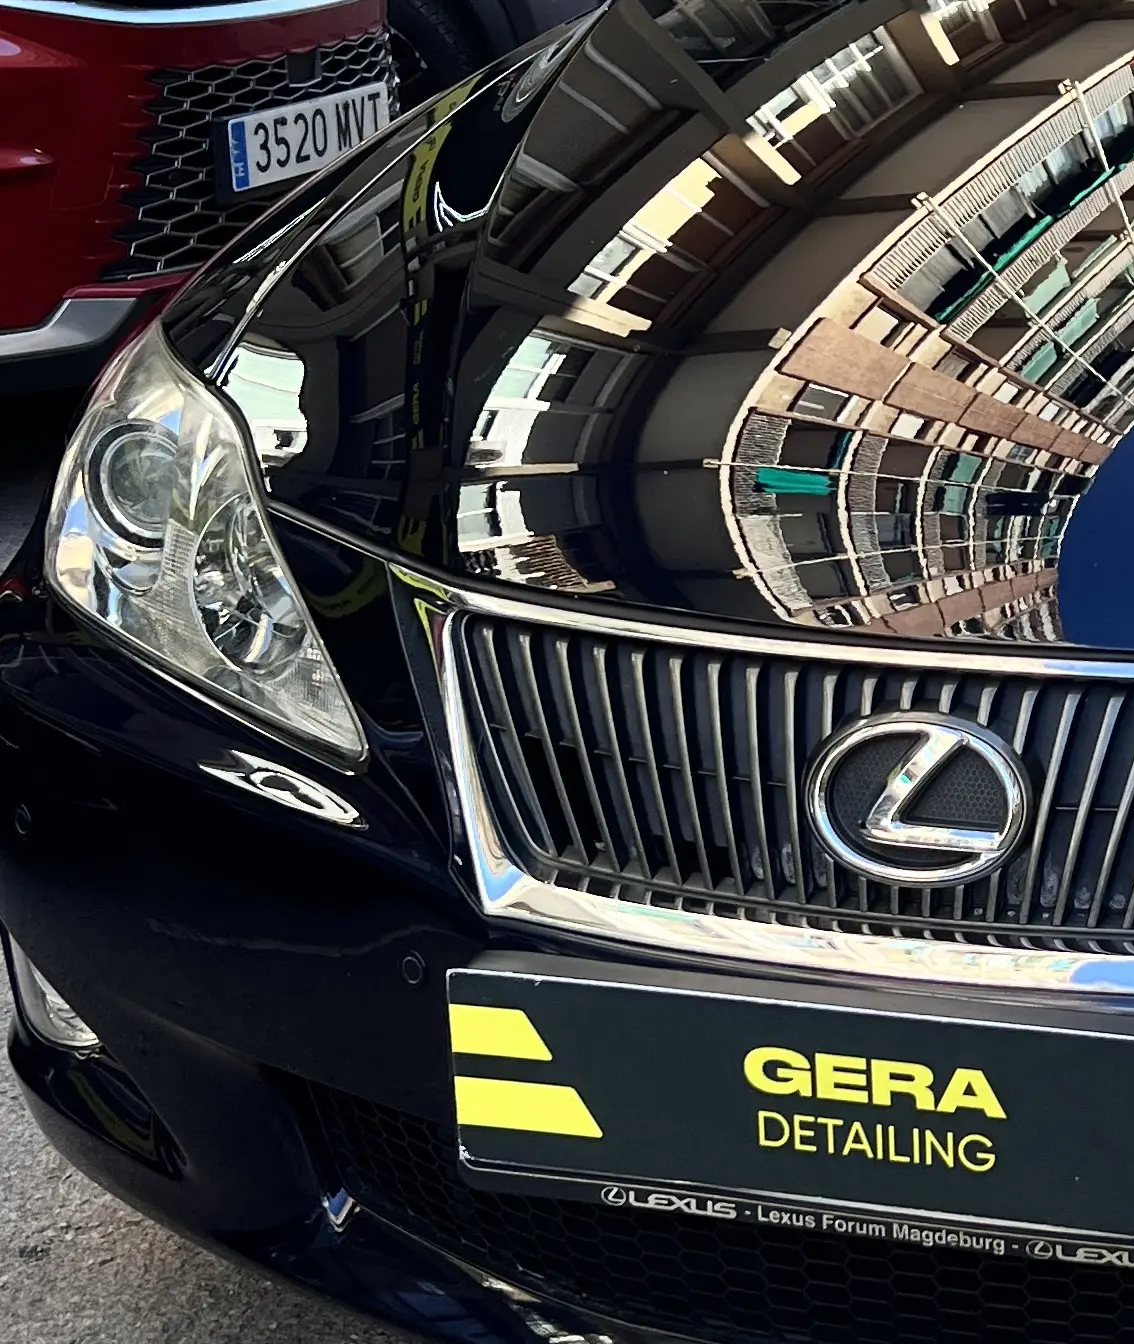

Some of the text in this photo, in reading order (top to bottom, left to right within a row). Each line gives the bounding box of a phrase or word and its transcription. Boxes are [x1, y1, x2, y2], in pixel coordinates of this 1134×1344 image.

[254, 92, 381, 173] 3520 MVT
[743, 1046, 1007, 1119] GERA
[758, 1110, 996, 1172] DETAILING
[628, 1190, 737, 1219] LEXUS
[757, 1204, 816, 1228] Lexus
[822, 1214, 886, 1238] Forum
[892, 1223, 1005, 1255] Magdeburg
